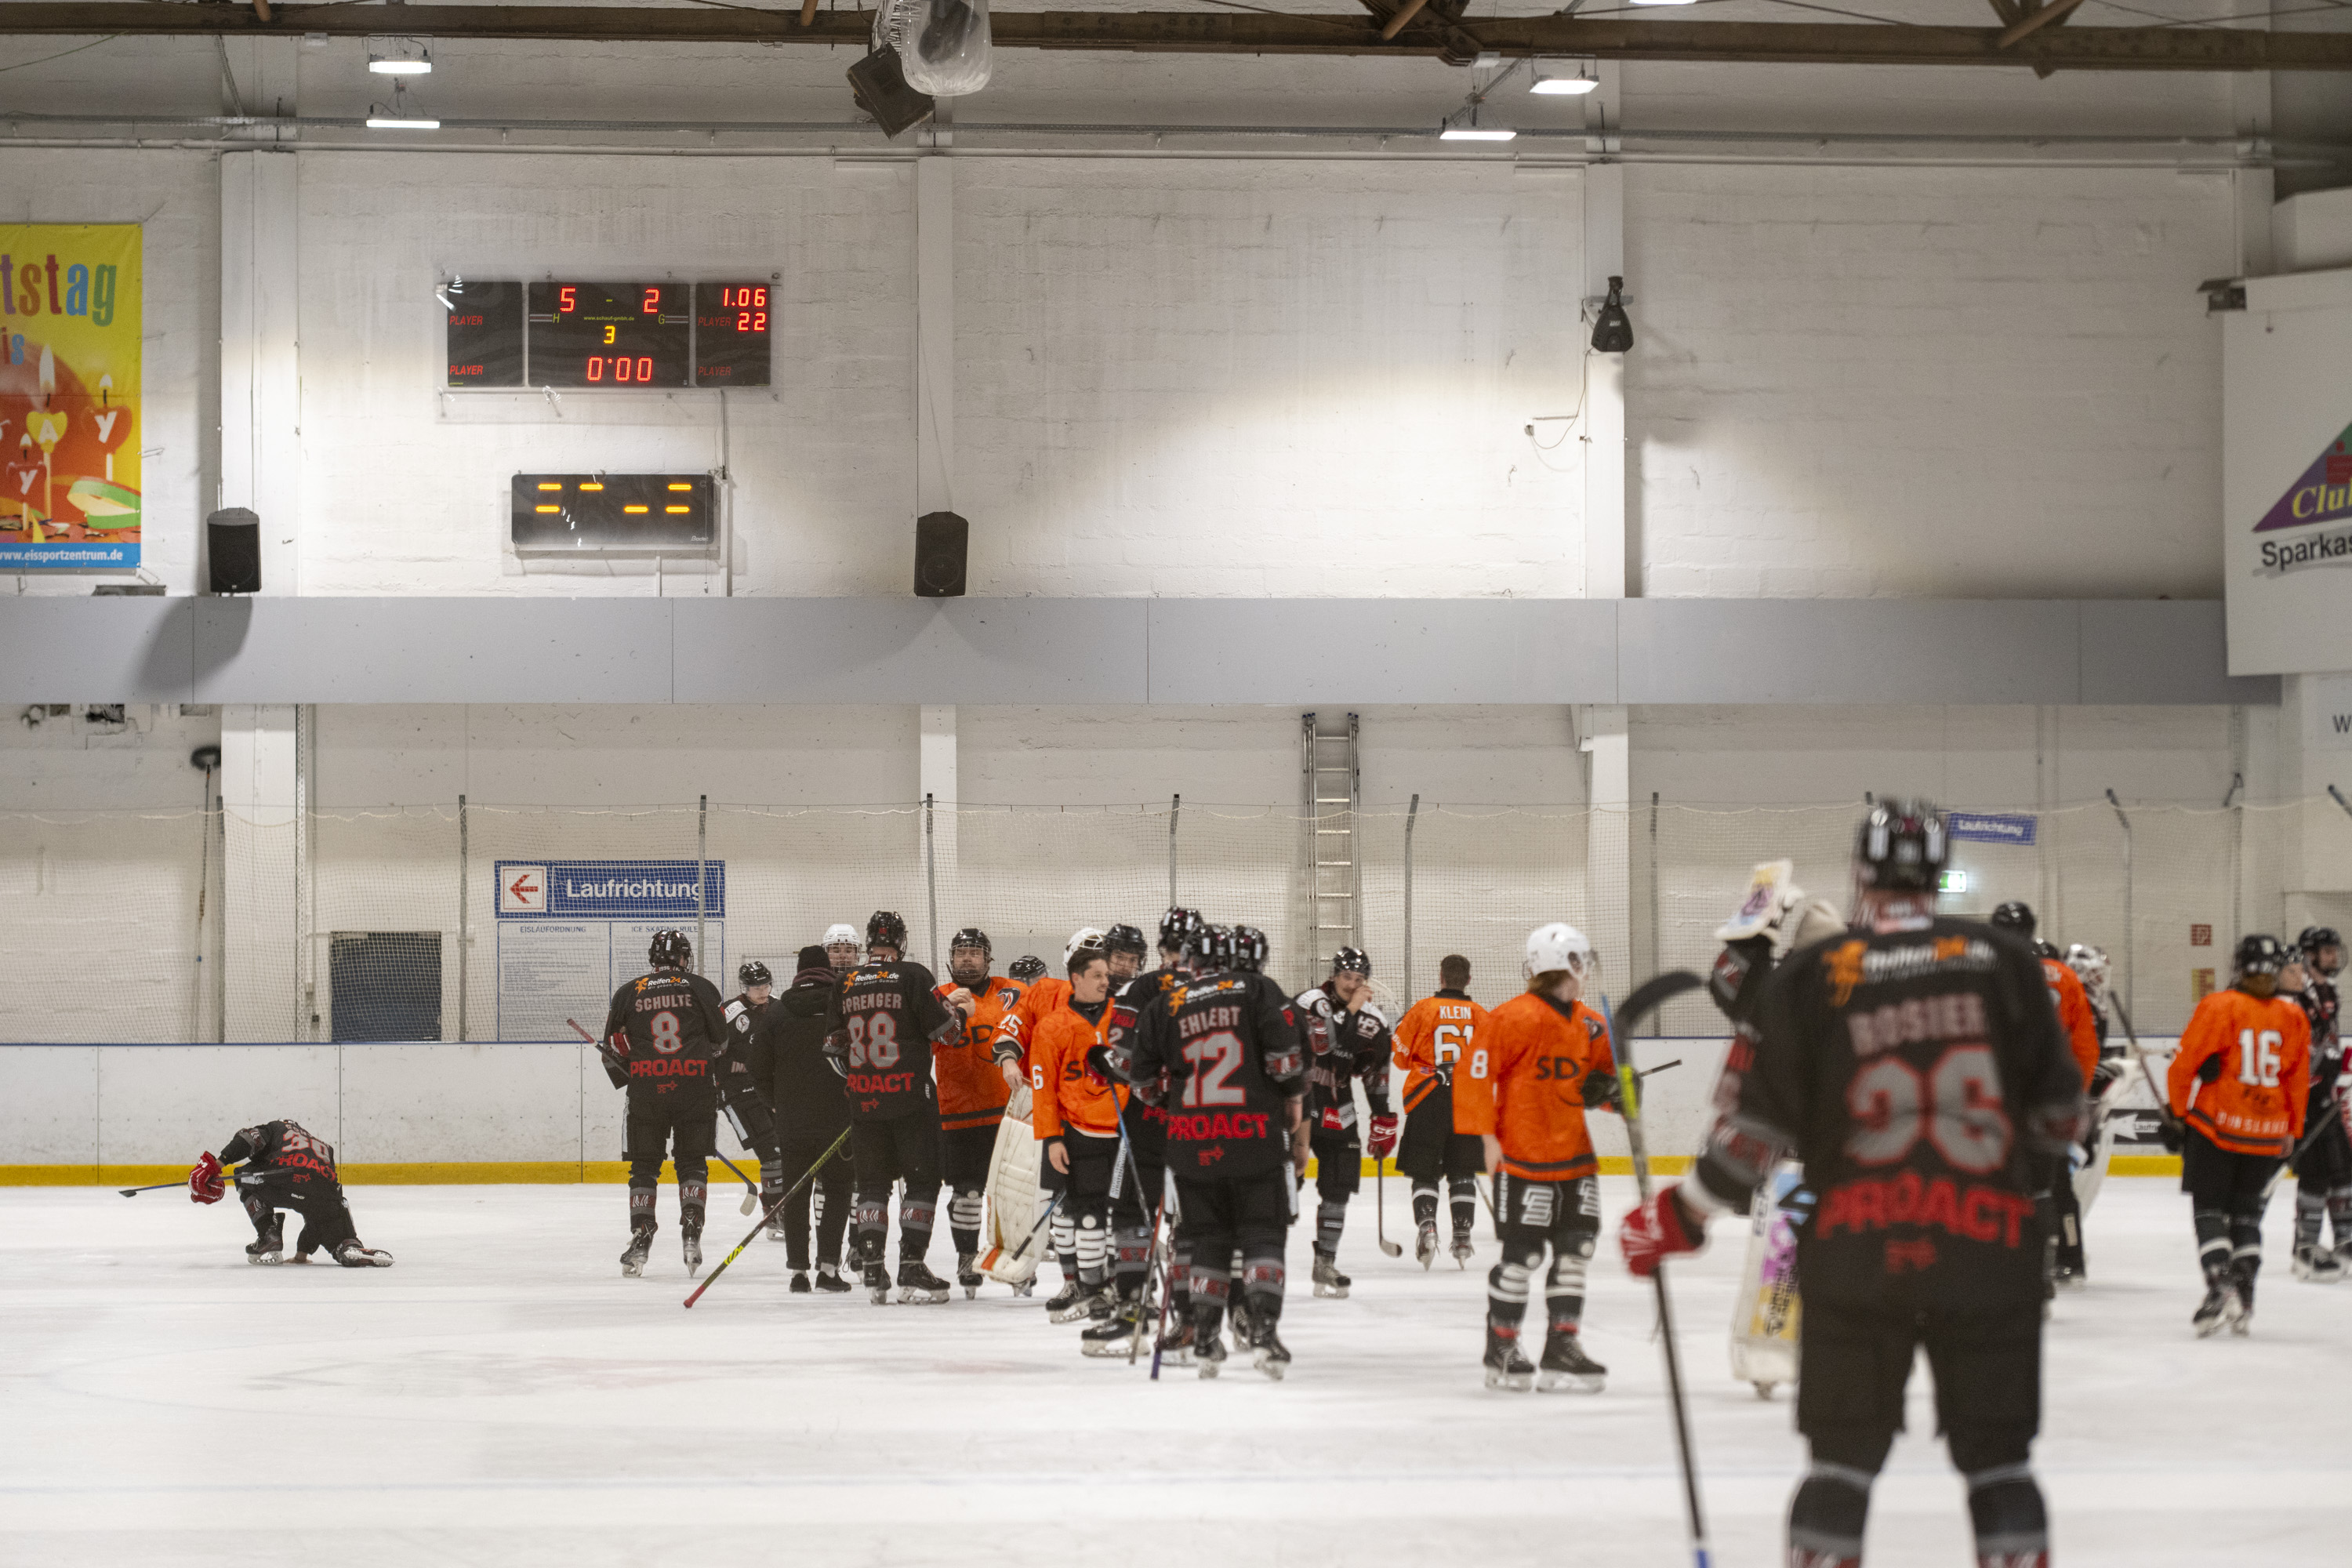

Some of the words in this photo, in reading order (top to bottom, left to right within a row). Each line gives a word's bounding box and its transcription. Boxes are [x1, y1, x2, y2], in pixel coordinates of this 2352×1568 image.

[560, 287, 575, 312] 5
[644, 289, 659, 313] 2
[724, 288, 766, 307] 1.06
[449, 315, 483, 325] PLAYER
[698, 317, 731, 327] PLAYER
[738, 312, 766, 331] 22
[604, 325, 615, 344] 3
[449, 365, 483, 376] PLAYER
[698, 366, 731, 376] PLAYER
[2292, 477, 2352, 518] Clu
[2262, 533, 2352, 572] Sparka
[855, 971, 899, 982] Reifen24.de
[635, 994, 692, 1012] SCHULTE
[1439, 1006, 1472, 1019] KLEIN
[651, 1011, 683, 1054] 8
[848, 1011, 900, 1069] 88
[1433, 1024, 1474, 1067] 61
[630, 1058, 708, 1078] PROACT
[1181, 1031, 1246, 1109] 12
[1470, 1049, 1488, 1079] 8
[2238, 1029, 2282, 1088] 16
[847, 1073, 915, 1093] ROACT
[1032, 1065, 1044, 1091] 6
[1167, 1112, 1269, 1141] PROACT
[1816, 1170, 2035, 1249] PROACT
